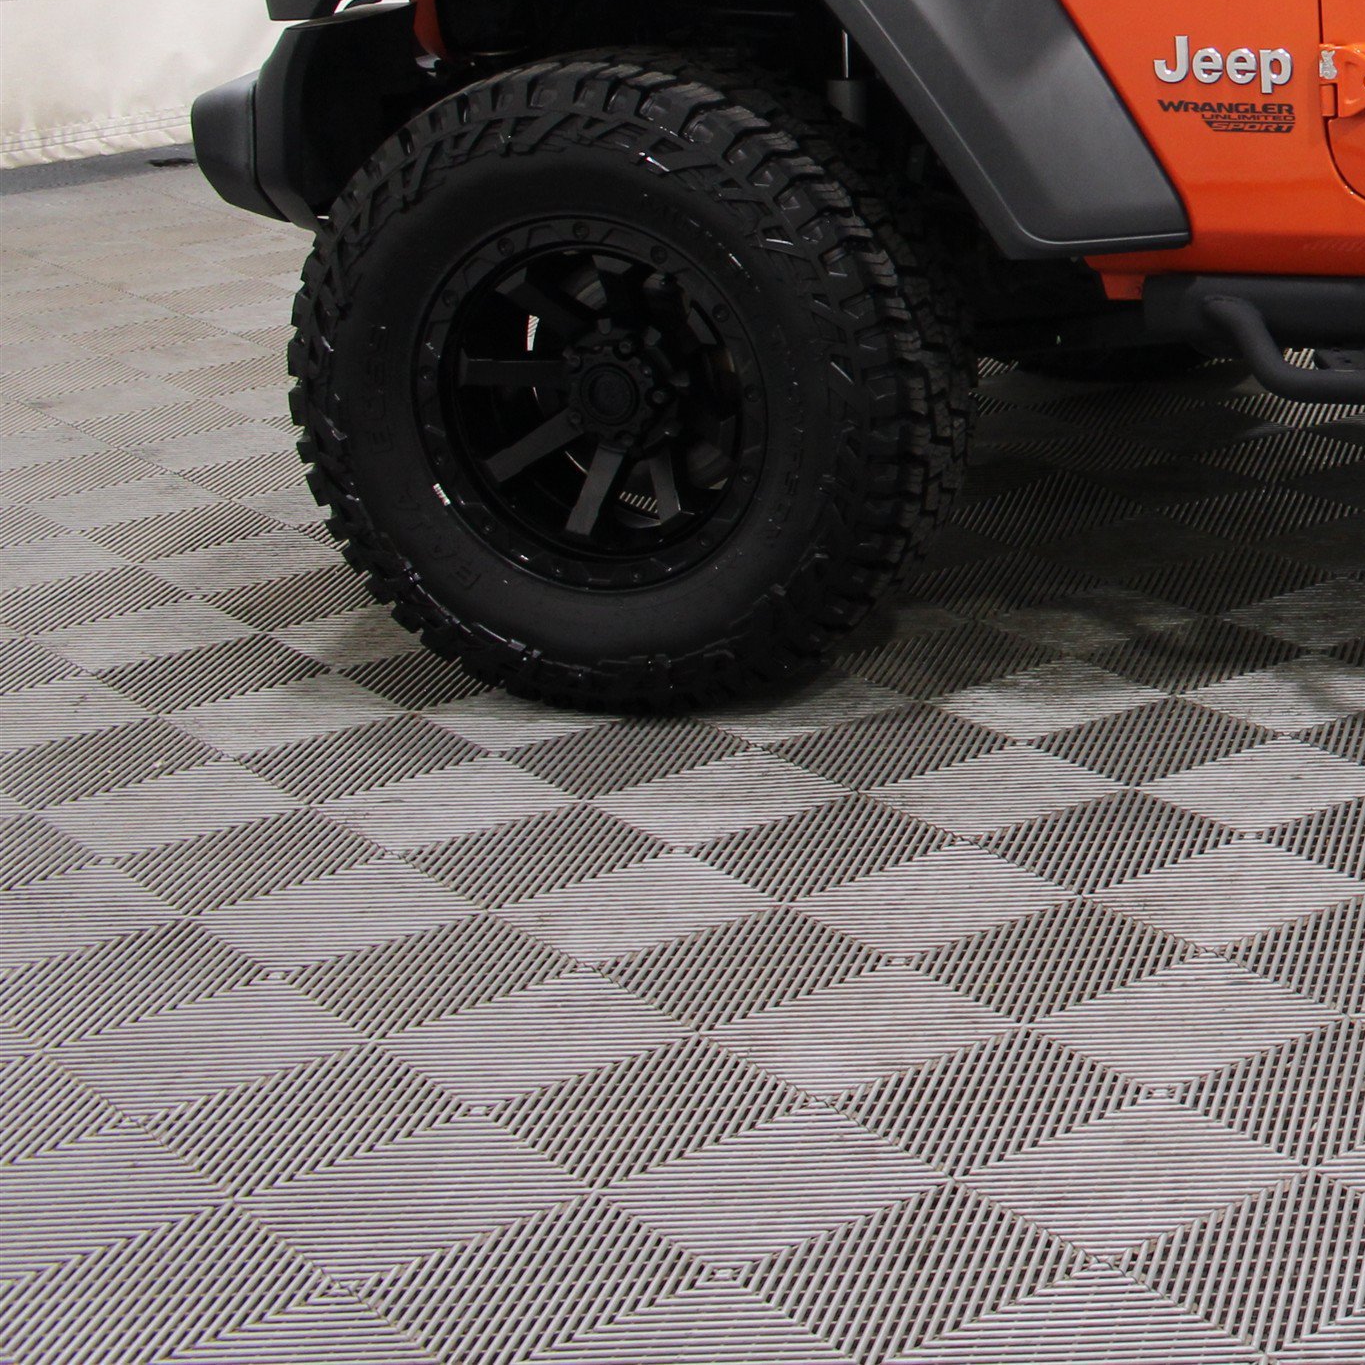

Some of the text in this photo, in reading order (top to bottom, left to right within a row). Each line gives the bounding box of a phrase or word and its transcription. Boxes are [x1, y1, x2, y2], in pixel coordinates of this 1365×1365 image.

[1153, 35, 1293, 94] Jeep
[1157, 99, 1294, 115] WRANGLER
[1211, 121, 1293, 132] SPORT
